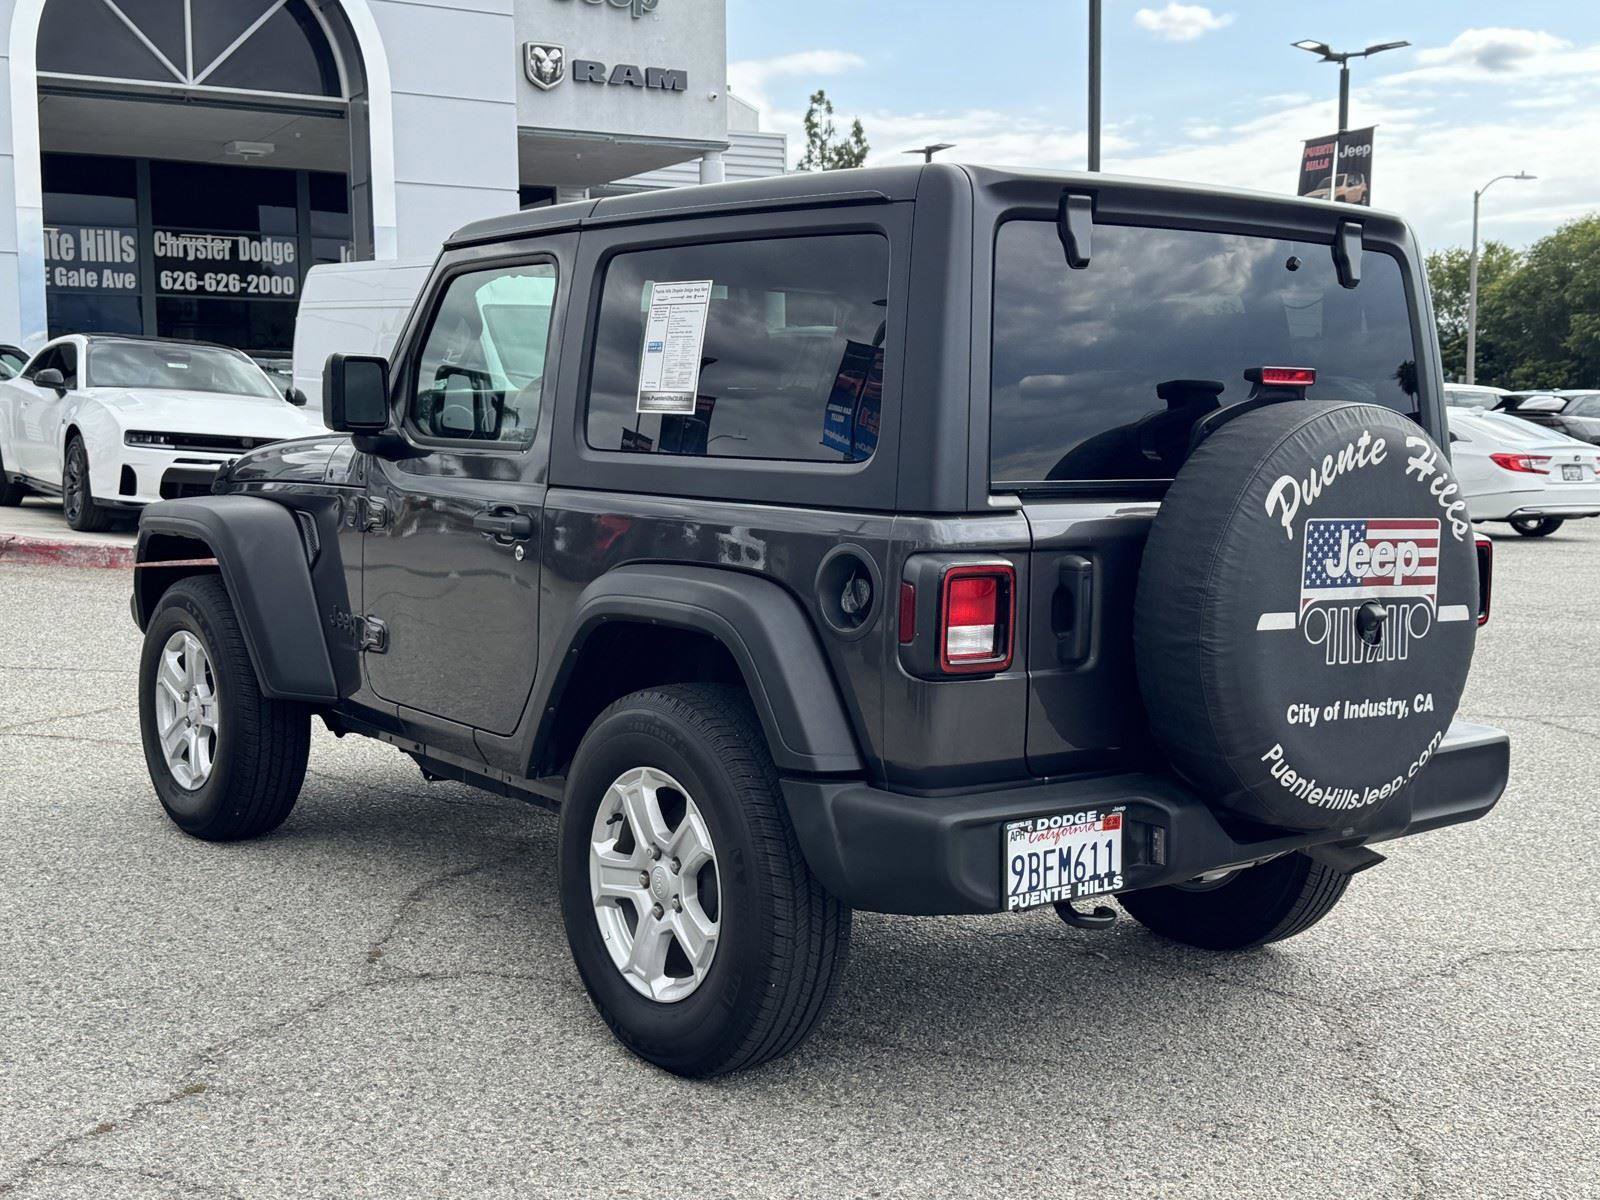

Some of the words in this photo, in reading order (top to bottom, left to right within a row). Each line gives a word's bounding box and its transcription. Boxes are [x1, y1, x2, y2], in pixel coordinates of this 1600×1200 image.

[573, 59, 688, 91] RAM
[1305, 158, 1329, 172] HILLS
[1339, 144, 1371, 158] Jeep
[80, 228, 136, 263] Hills
[154, 231, 232, 261] Chrysler
[239, 236, 295, 264] Dodge
[54, 267, 98, 288] Gale
[102, 269, 136, 290] Ave
[160, 270, 295, 295] 626-626-2000
[1265, 430, 1387, 541] Puente
[1406, 436, 1469, 542] Hills
[1323, 530, 1420, 586] Jeep
[1287, 704, 1319, 727] City
[1323, 701, 1341, 721] of
[1344, 697, 1409, 720] Industry,
[1413, 693, 1434, 713] CA
[1260, 730, 1442, 810] PuenteHillsJeep.com
[1028, 822, 1097, 845] California
[1037, 810, 1097, 831] DODGE
[1011, 839, 1117, 895] 9BFM611
[1008, 885, 1071, 910] PUENTE
[1077, 875, 1123, 897] HILLS
